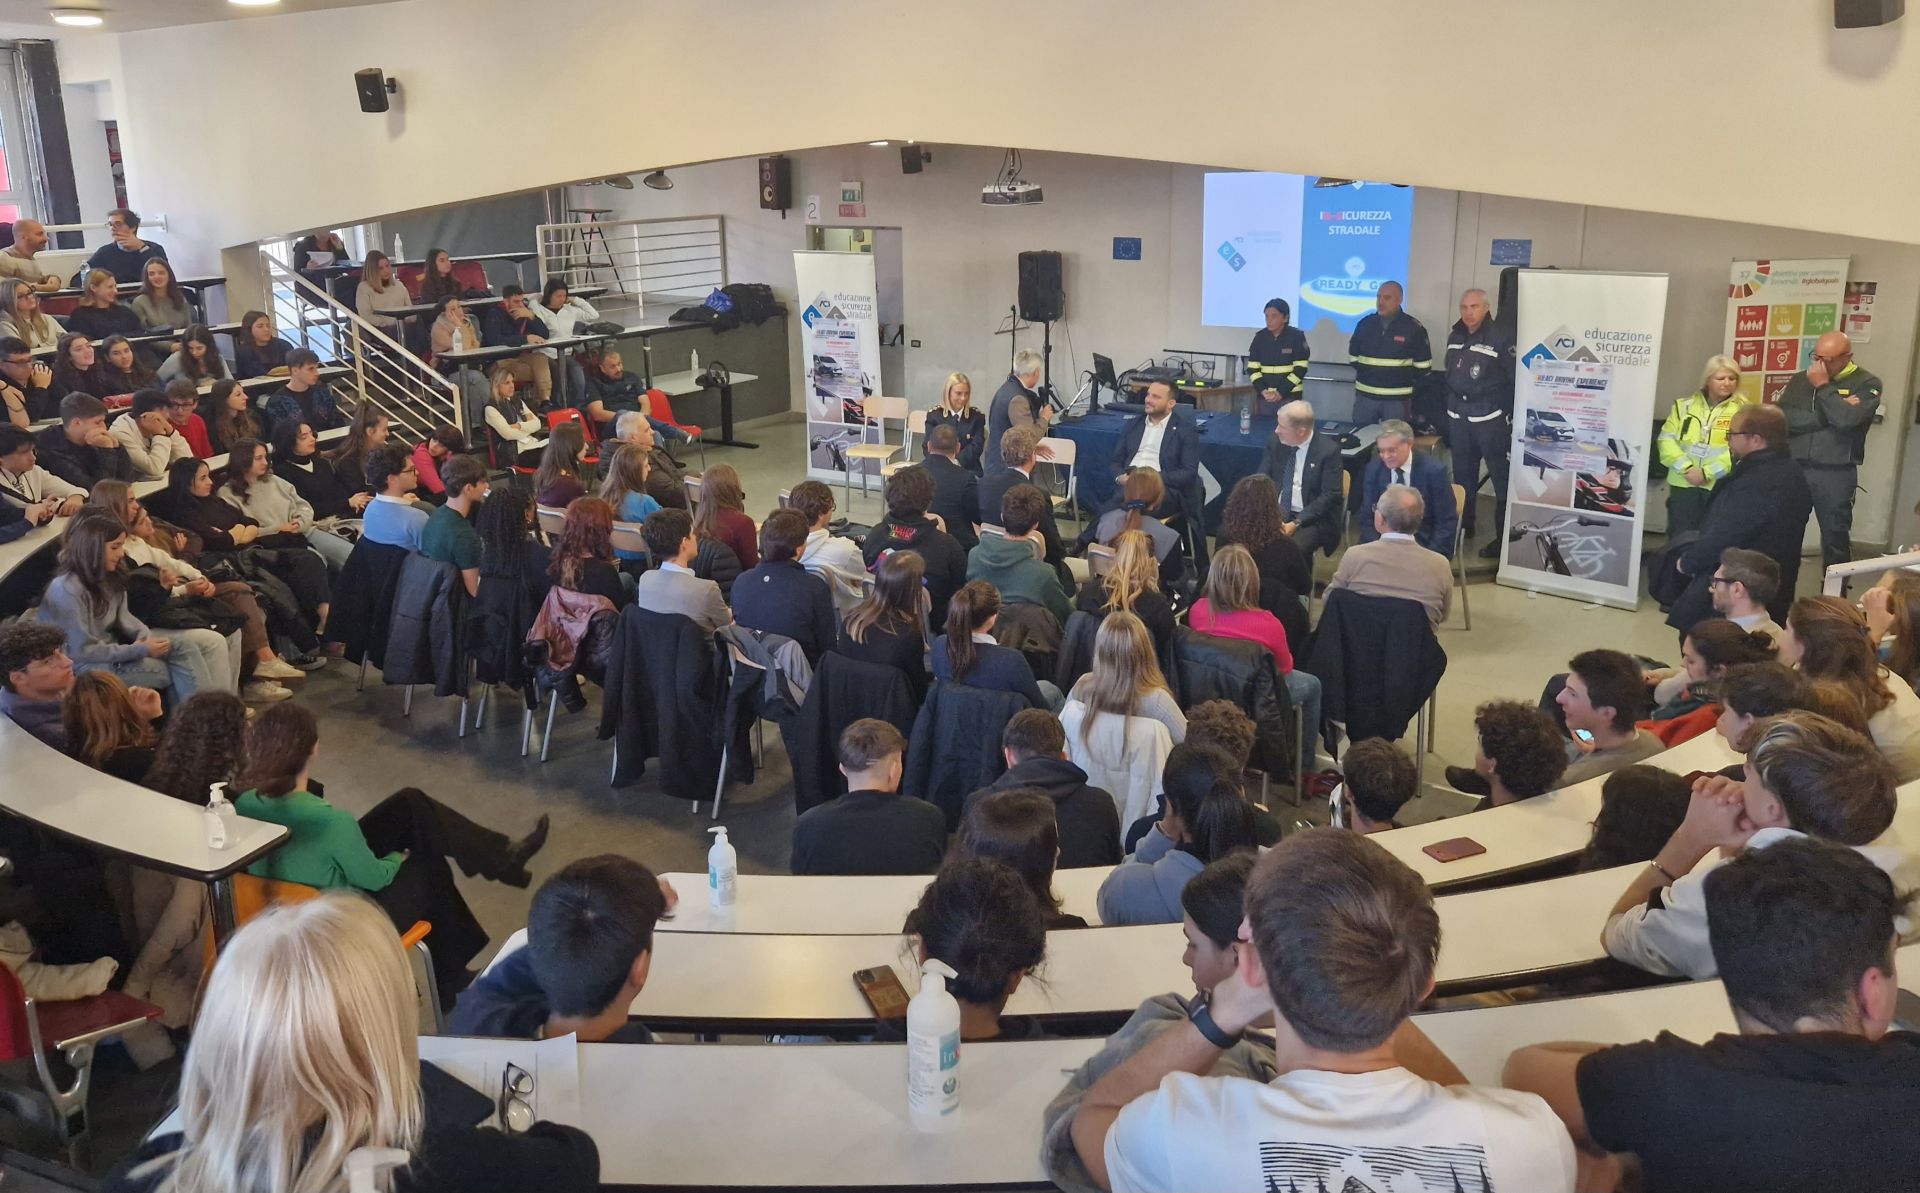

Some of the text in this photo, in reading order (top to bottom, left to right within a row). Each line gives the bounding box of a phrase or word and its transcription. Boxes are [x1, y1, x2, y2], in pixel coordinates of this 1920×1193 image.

[808, 203, 817, 219] 2
[1328, 225, 1381, 235] STRADALE
[1319, 280, 1362, 290] READY
[834, 292, 871, 302] educazione
[842, 302, 872, 311] sicurezza
[847, 311, 872, 319] stradale
[1584, 328, 1653, 343] educazione
[1555, 338, 1575, 348] ACI
[1596, 340, 1651, 354] sicurezza
[1603, 354, 1650, 367] stradale
